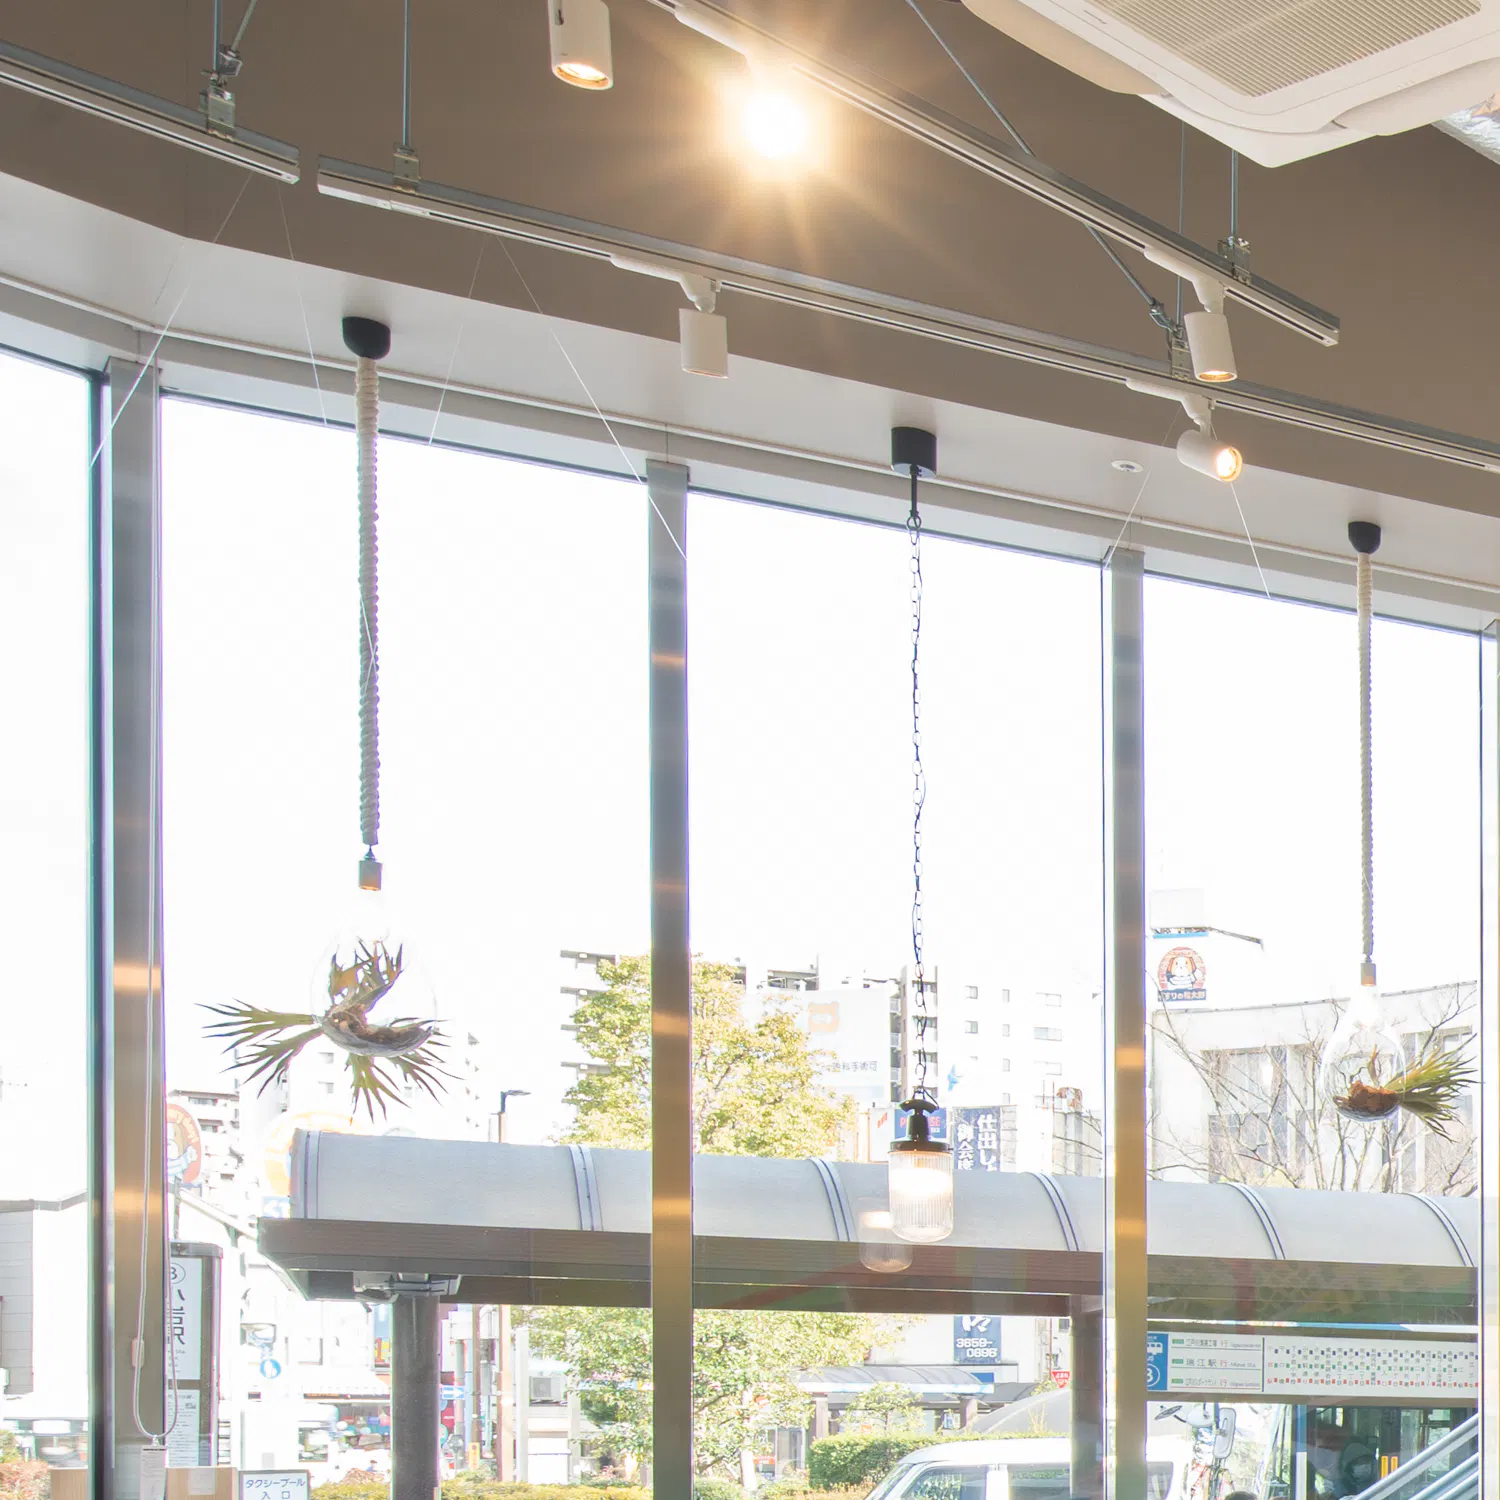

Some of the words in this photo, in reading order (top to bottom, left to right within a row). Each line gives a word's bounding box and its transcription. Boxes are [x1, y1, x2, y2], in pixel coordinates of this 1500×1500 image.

[246, 1478, 306, 1488] タクシープール
